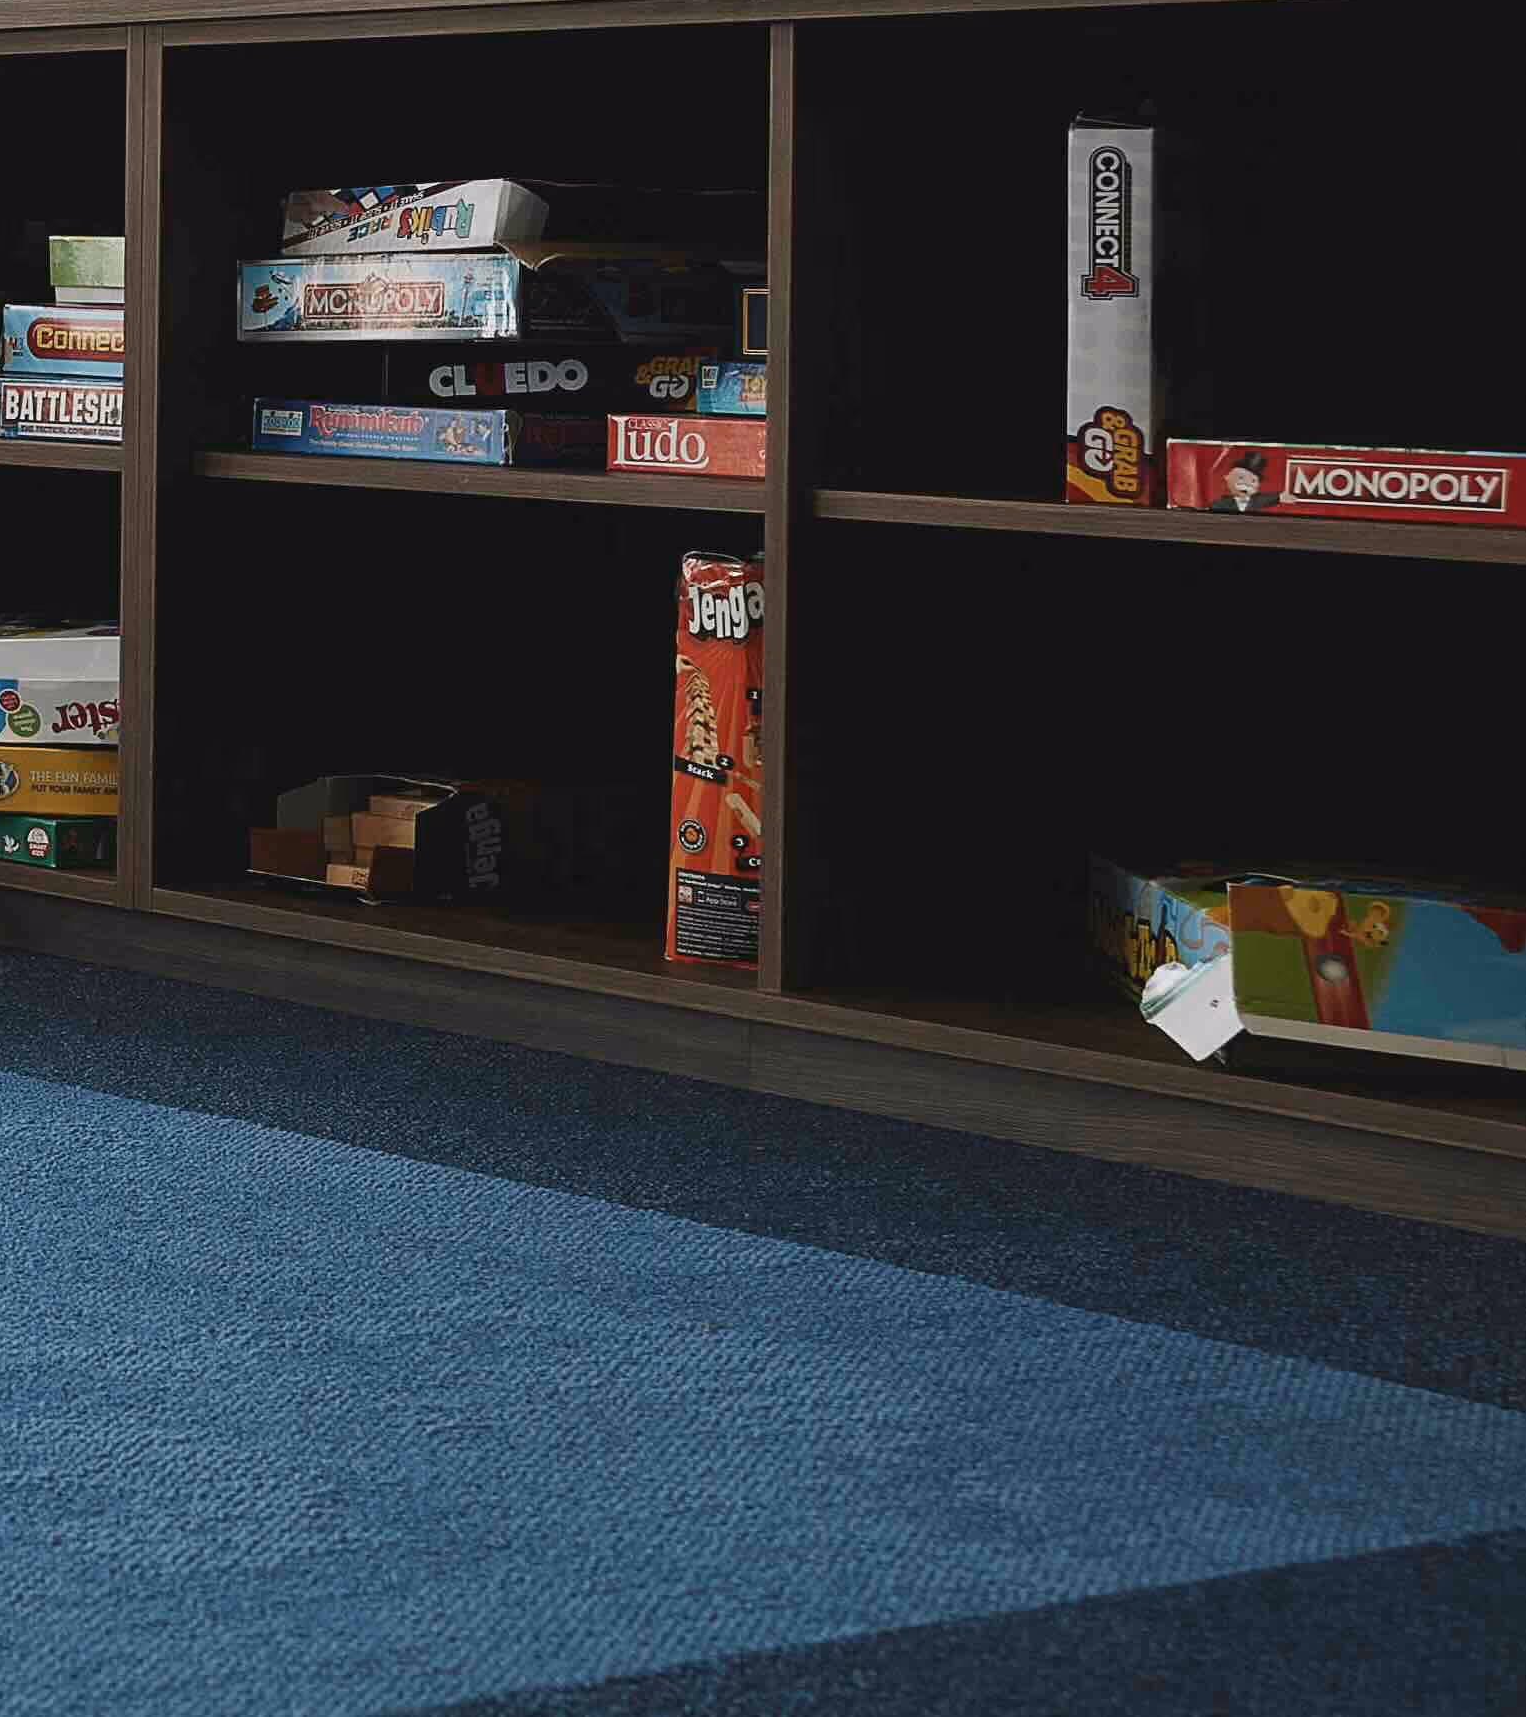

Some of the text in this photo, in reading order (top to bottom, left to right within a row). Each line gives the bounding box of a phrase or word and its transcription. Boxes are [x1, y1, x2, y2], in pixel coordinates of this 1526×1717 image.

[1085, 151, 1135, 296] CONNECT 4
[1113, 428, 1139, 491] GRAB
[1293, 466, 1500, 503] MONOPOLY
[687, 582, 765, 640] Jenga
[29, 770, 53, 783] THE
